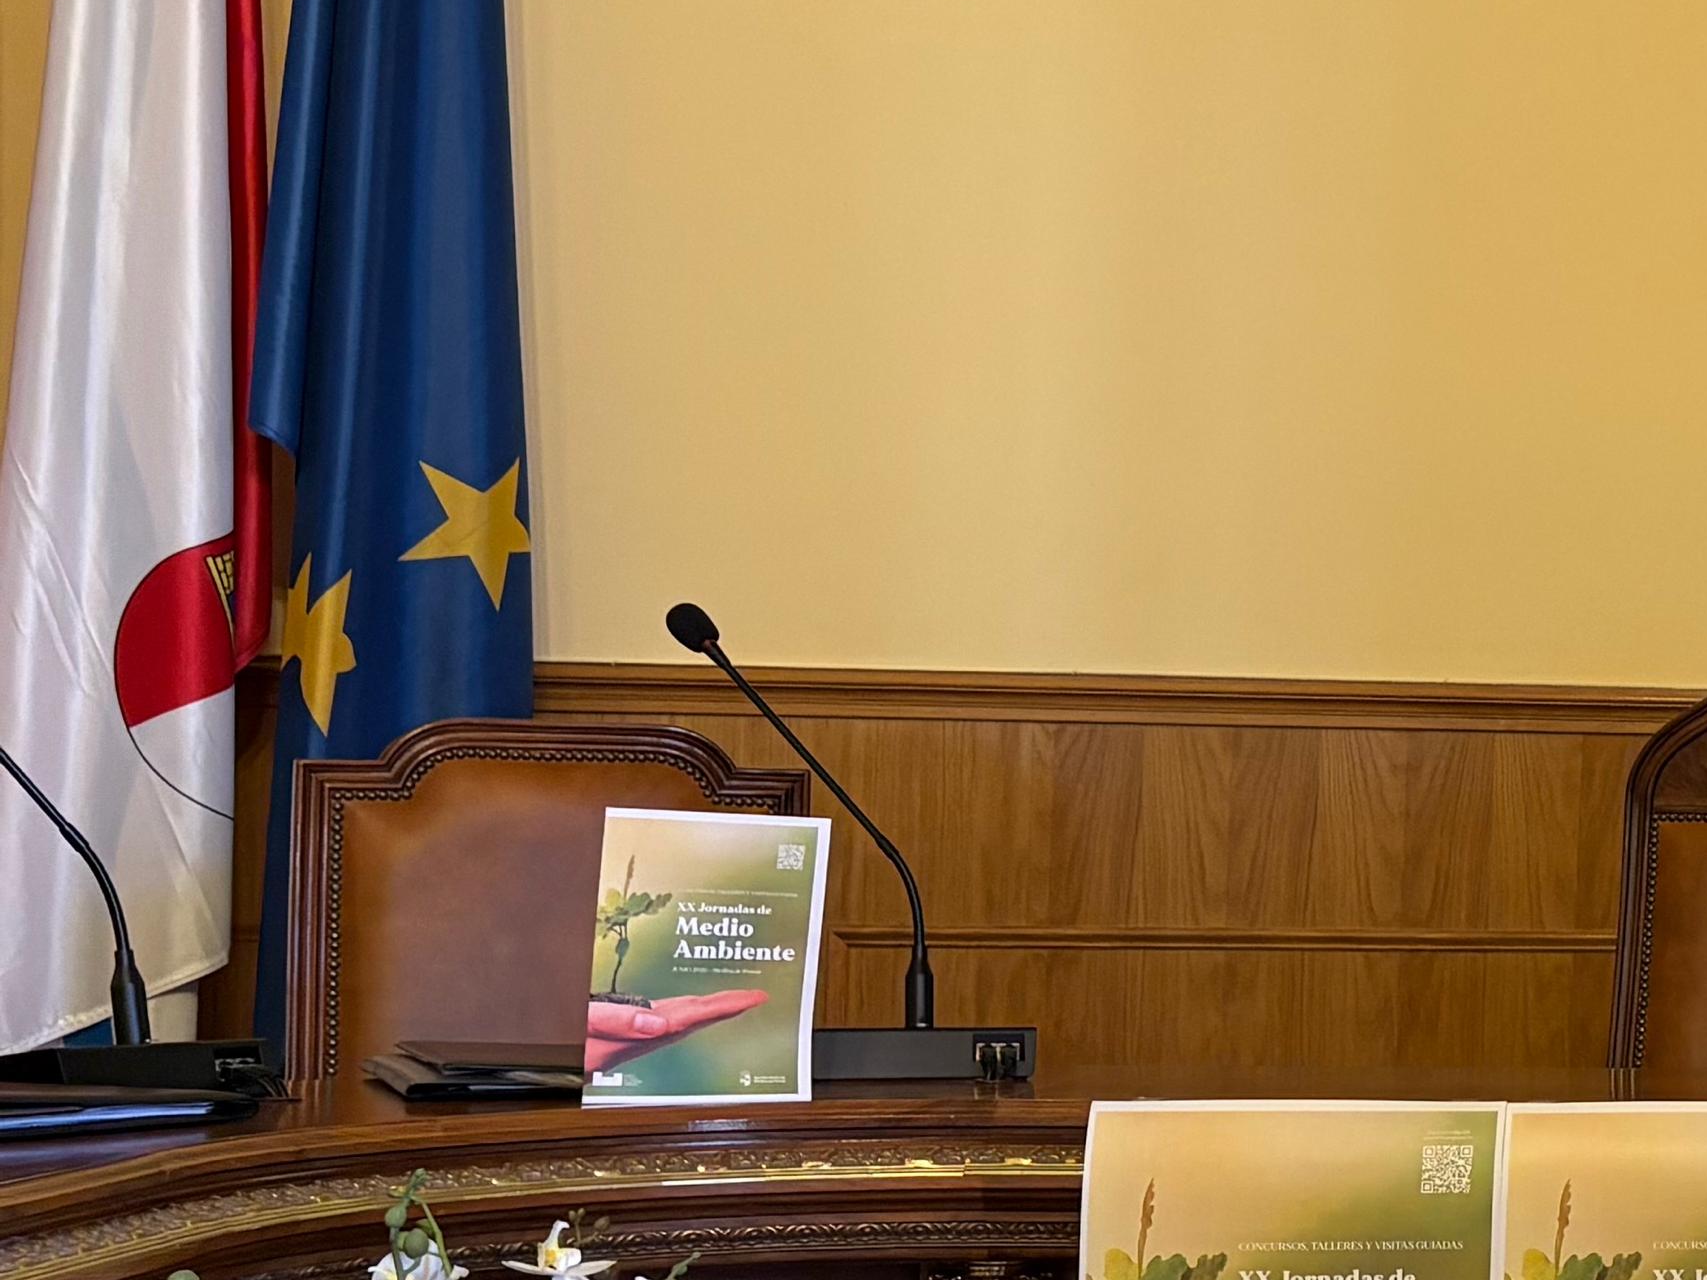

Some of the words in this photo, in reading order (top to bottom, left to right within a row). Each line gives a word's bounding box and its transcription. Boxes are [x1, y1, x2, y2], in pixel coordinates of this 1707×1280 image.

[677, 901, 696, 913] XX
[697, 901, 756, 915] Jornadas
[756, 904, 773, 915] de
[675, 915, 754, 938] Medio
[673, 938, 796, 962] Ambiente
[1237, 1241, 1310, 1253] CONCURSOS,
[1311, 1240, 1364, 1251] TALLERES
[1365, 1240, 1373, 1251] Y
[1374, 1240, 1415, 1251] VISITAS
[1415, 1239, 1464, 1251] GUIADAS
